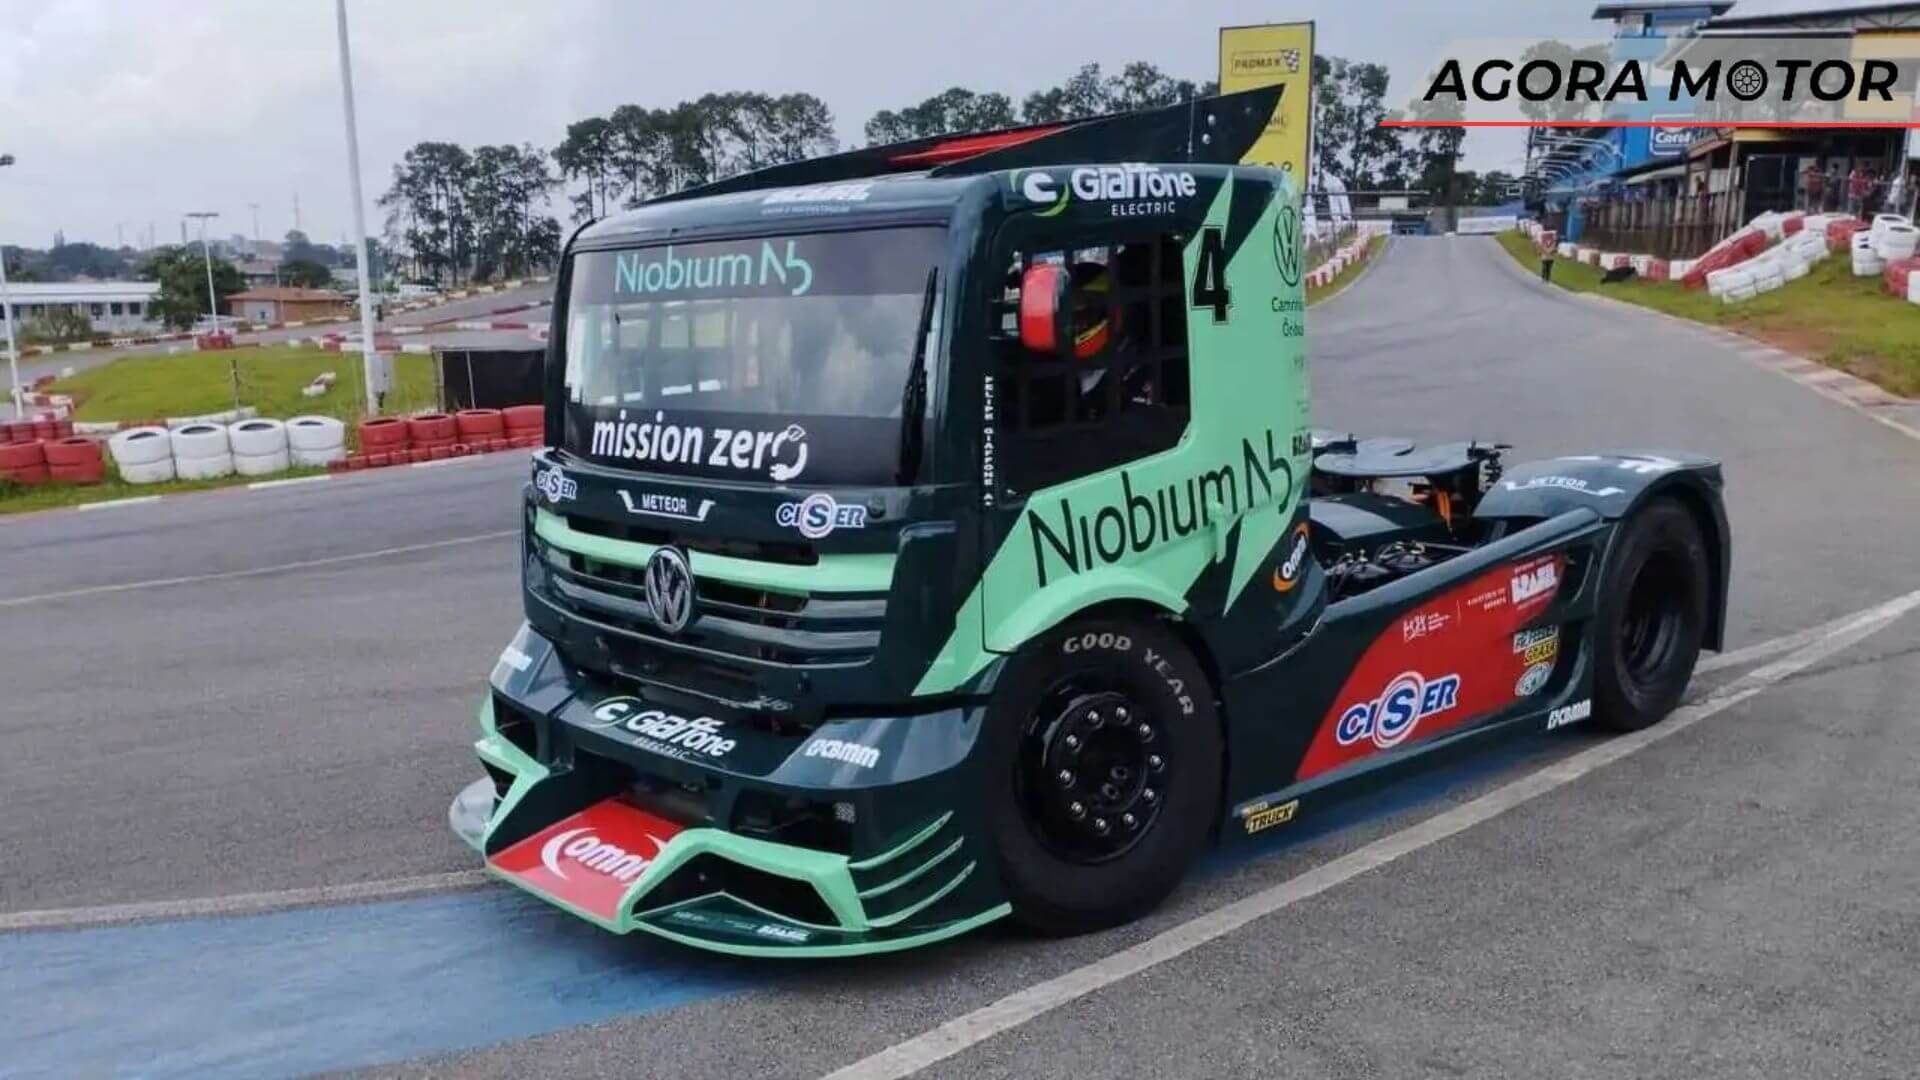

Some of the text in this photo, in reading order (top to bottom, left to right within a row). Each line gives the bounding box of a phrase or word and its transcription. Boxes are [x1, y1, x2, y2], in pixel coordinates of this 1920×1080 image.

[1071, 162, 1196, 201] Giaffone
[1111, 201, 1176, 216] ELECTRIC
[614, 245, 752, 293] Niobium
[1190, 225, 1233, 325] 4
[984, 376, 994, 420] FELIPE
[591, 410, 701, 465] mission
[984, 427, 994, 485] GIAFFONE
[537, 466, 577, 503] CISER
[642, 494, 687, 514] METEOR
[776, 493, 867, 538] CISER
[1028, 464, 1238, 588] Niobium
[1063, 632, 1195, 714] GOOD YEAR
[626, 710, 737, 756] Giaffone
[1336, 671, 1461, 748] CISER
[564, 836, 652, 888] omn
